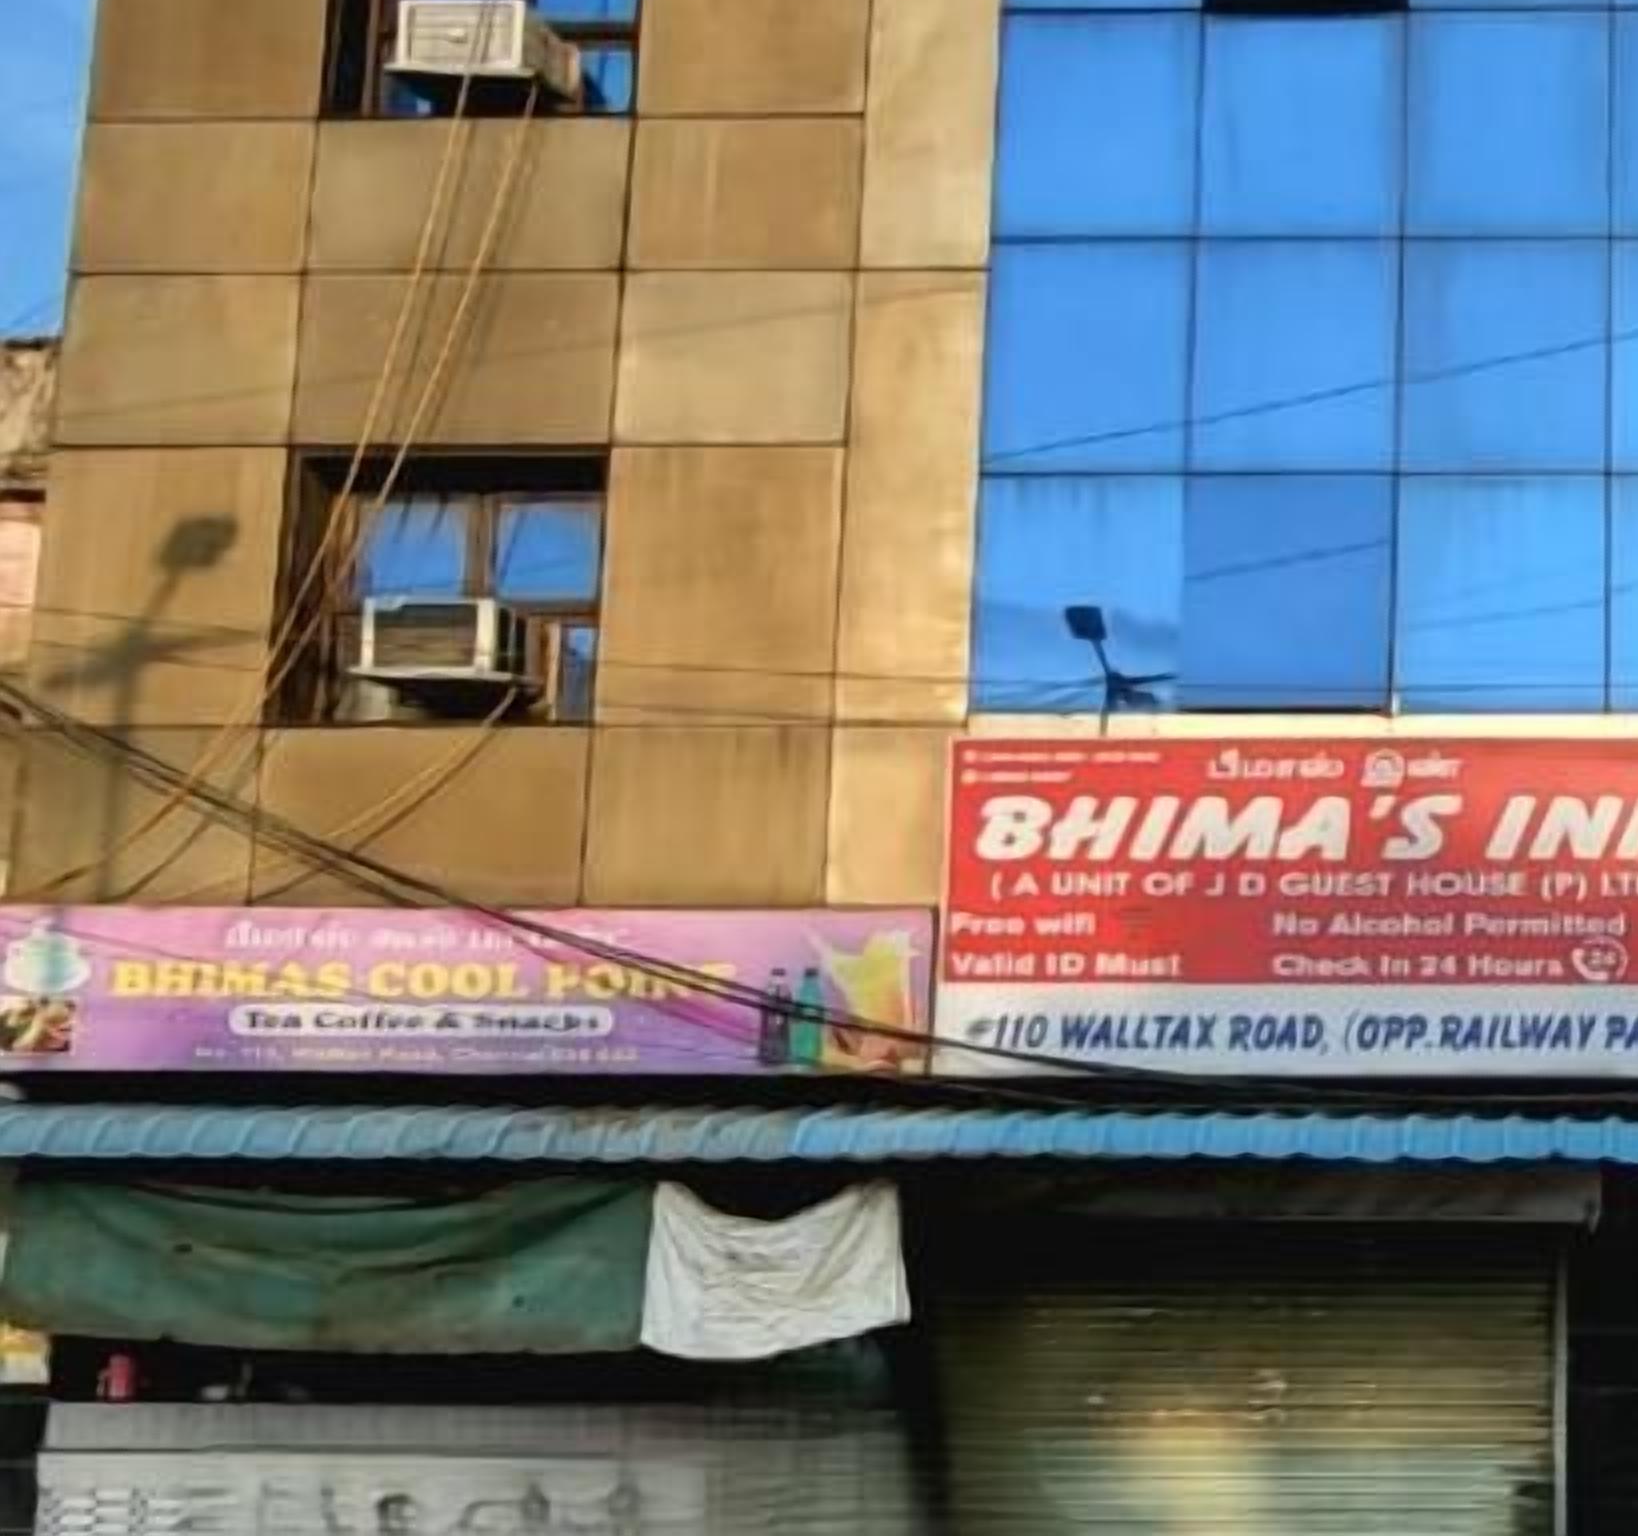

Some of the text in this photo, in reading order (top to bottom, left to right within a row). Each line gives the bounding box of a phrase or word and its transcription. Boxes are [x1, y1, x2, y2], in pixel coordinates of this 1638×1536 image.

[976, 795, 1463, 862] BHIMA'S
[1052, 873, 1131, 896] UNIT
[1142, 873, 1194, 896] OF
[1205, 873, 1226, 896] J
[1279, 873, 1393, 897] GUEST
[1407, 872, 1526, 897] HOUSE
[1541, 872, 1588, 902] (P)
[951, 913, 1026, 935] Free
[1272, 912, 1629, 936] No Alcohol Permitted
[951, 953, 1182, 976] Valid ID Must
[1272, 953, 1370, 976] Check
[1420, 954, 1457, 976] 24
[1468, 954, 1564, 976] Hours
[112, 961, 351, 997] BHIMAS
[368, 962, 530, 998] COOL
[246, 1011, 302, 1029] Tea
[314, 1010, 424, 1029] Coffee
[1060, 1014, 1216, 1050] WALLTAX
